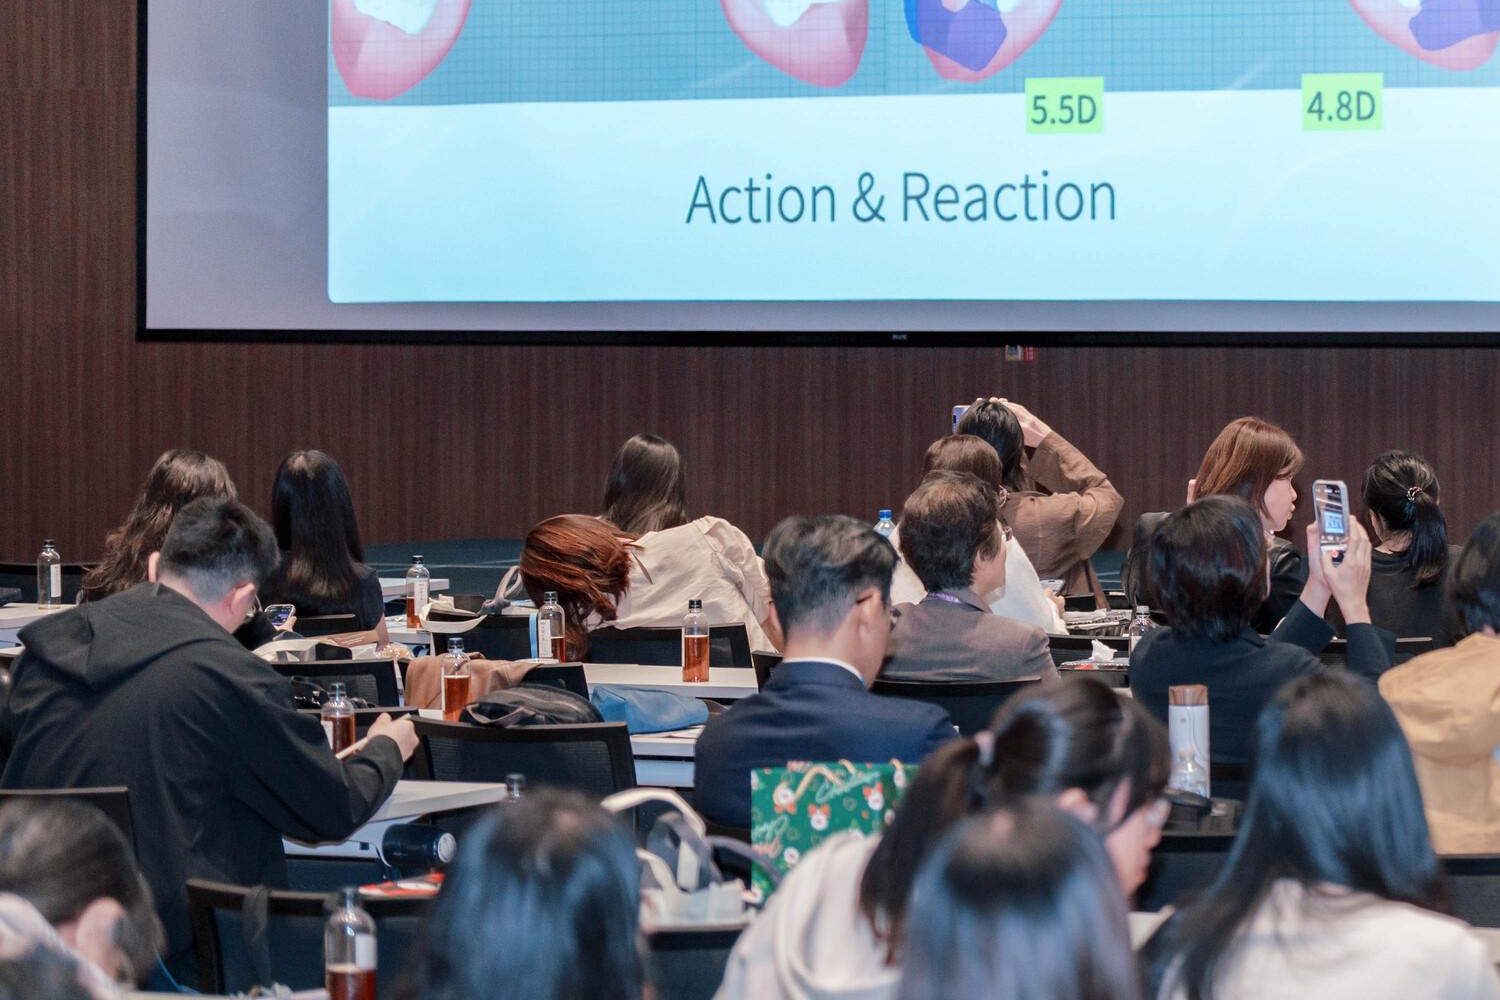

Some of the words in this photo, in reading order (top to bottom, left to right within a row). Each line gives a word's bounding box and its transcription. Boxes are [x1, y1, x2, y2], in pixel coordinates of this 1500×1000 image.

[1031, 94, 1097, 126] 5.5D
[1306, 88, 1376, 124] 4.8D
[685, 173, 835, 224] Action
[852, 171, 886, 223] &
[903, 170, 1115, 223] Reaction
